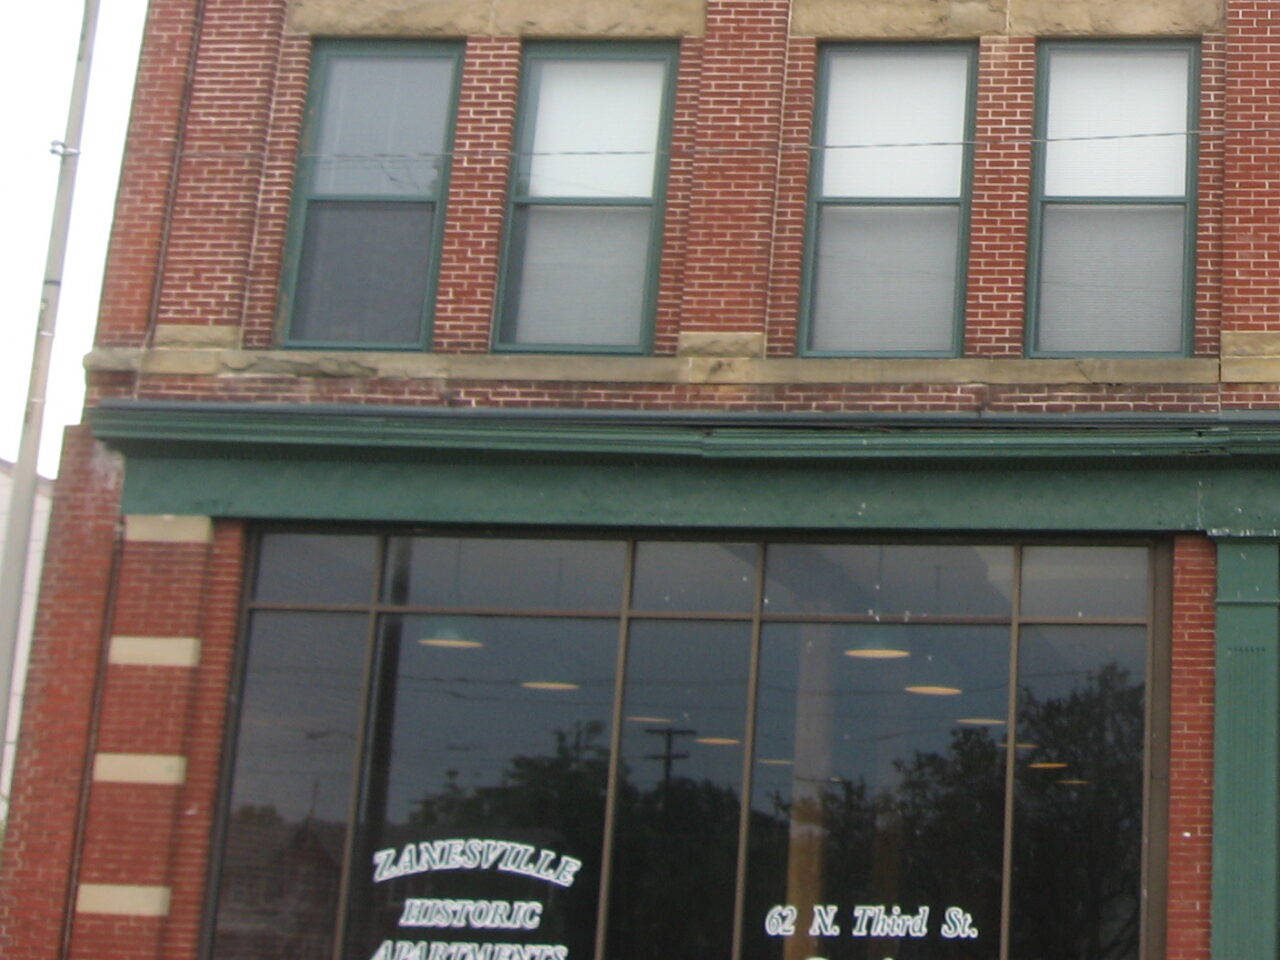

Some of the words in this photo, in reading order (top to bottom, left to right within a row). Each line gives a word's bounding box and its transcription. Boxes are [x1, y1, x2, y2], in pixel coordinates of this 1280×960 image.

[373, 839, 582, 887] ZANESVILLE
[399, 898, 543, 929] HISTORIC
[765, 905, 797, 936] 62
[809, 905, 841, 936] N.
[852, 905, 930, 937] Third
[941, 906, 979, 939] St.
[370, 940, 568, 960] APARTMENTS
